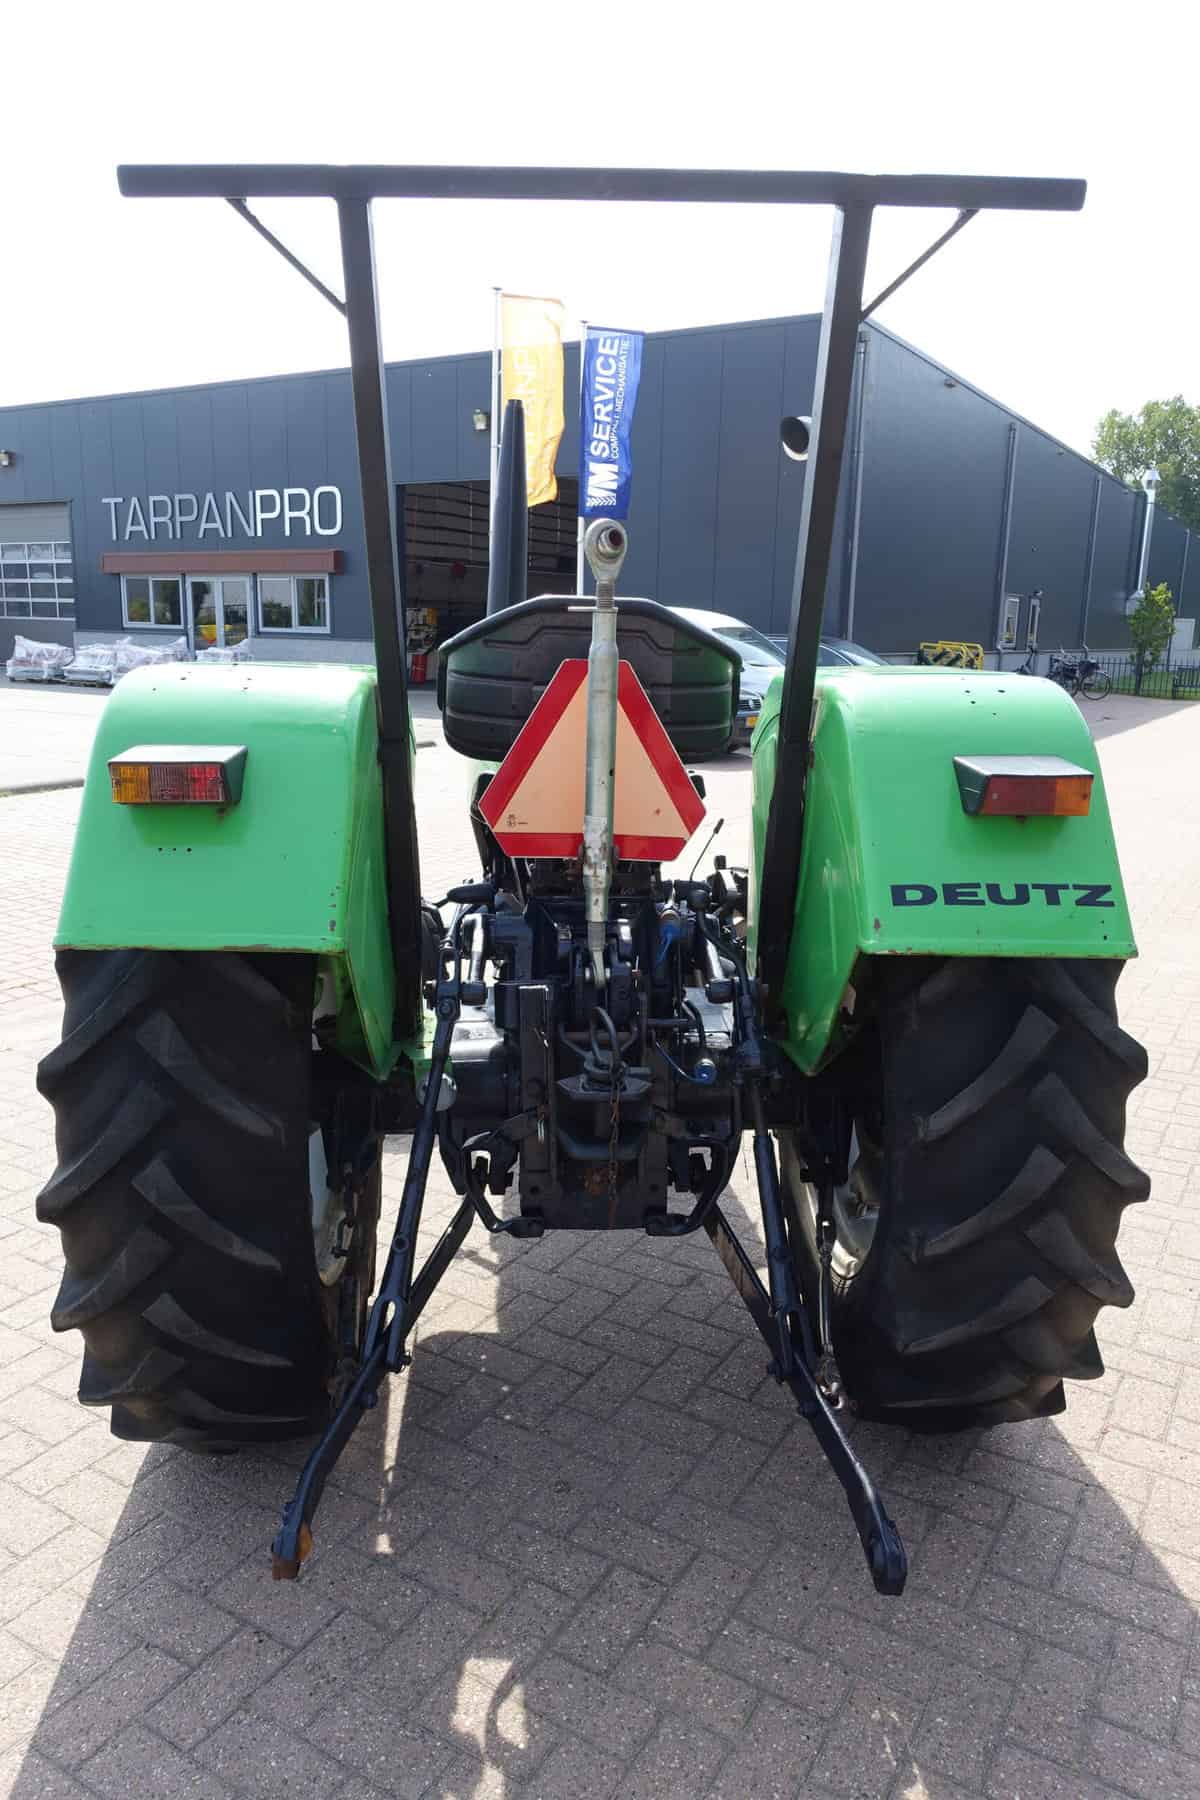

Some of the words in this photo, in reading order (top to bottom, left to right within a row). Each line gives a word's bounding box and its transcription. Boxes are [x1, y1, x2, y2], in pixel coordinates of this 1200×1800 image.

[591, 336, 620, 458] SERVICE
[102, 485, 343, 541] TARPANPRO
[890, 882, 1115, 907] DEUTZ
